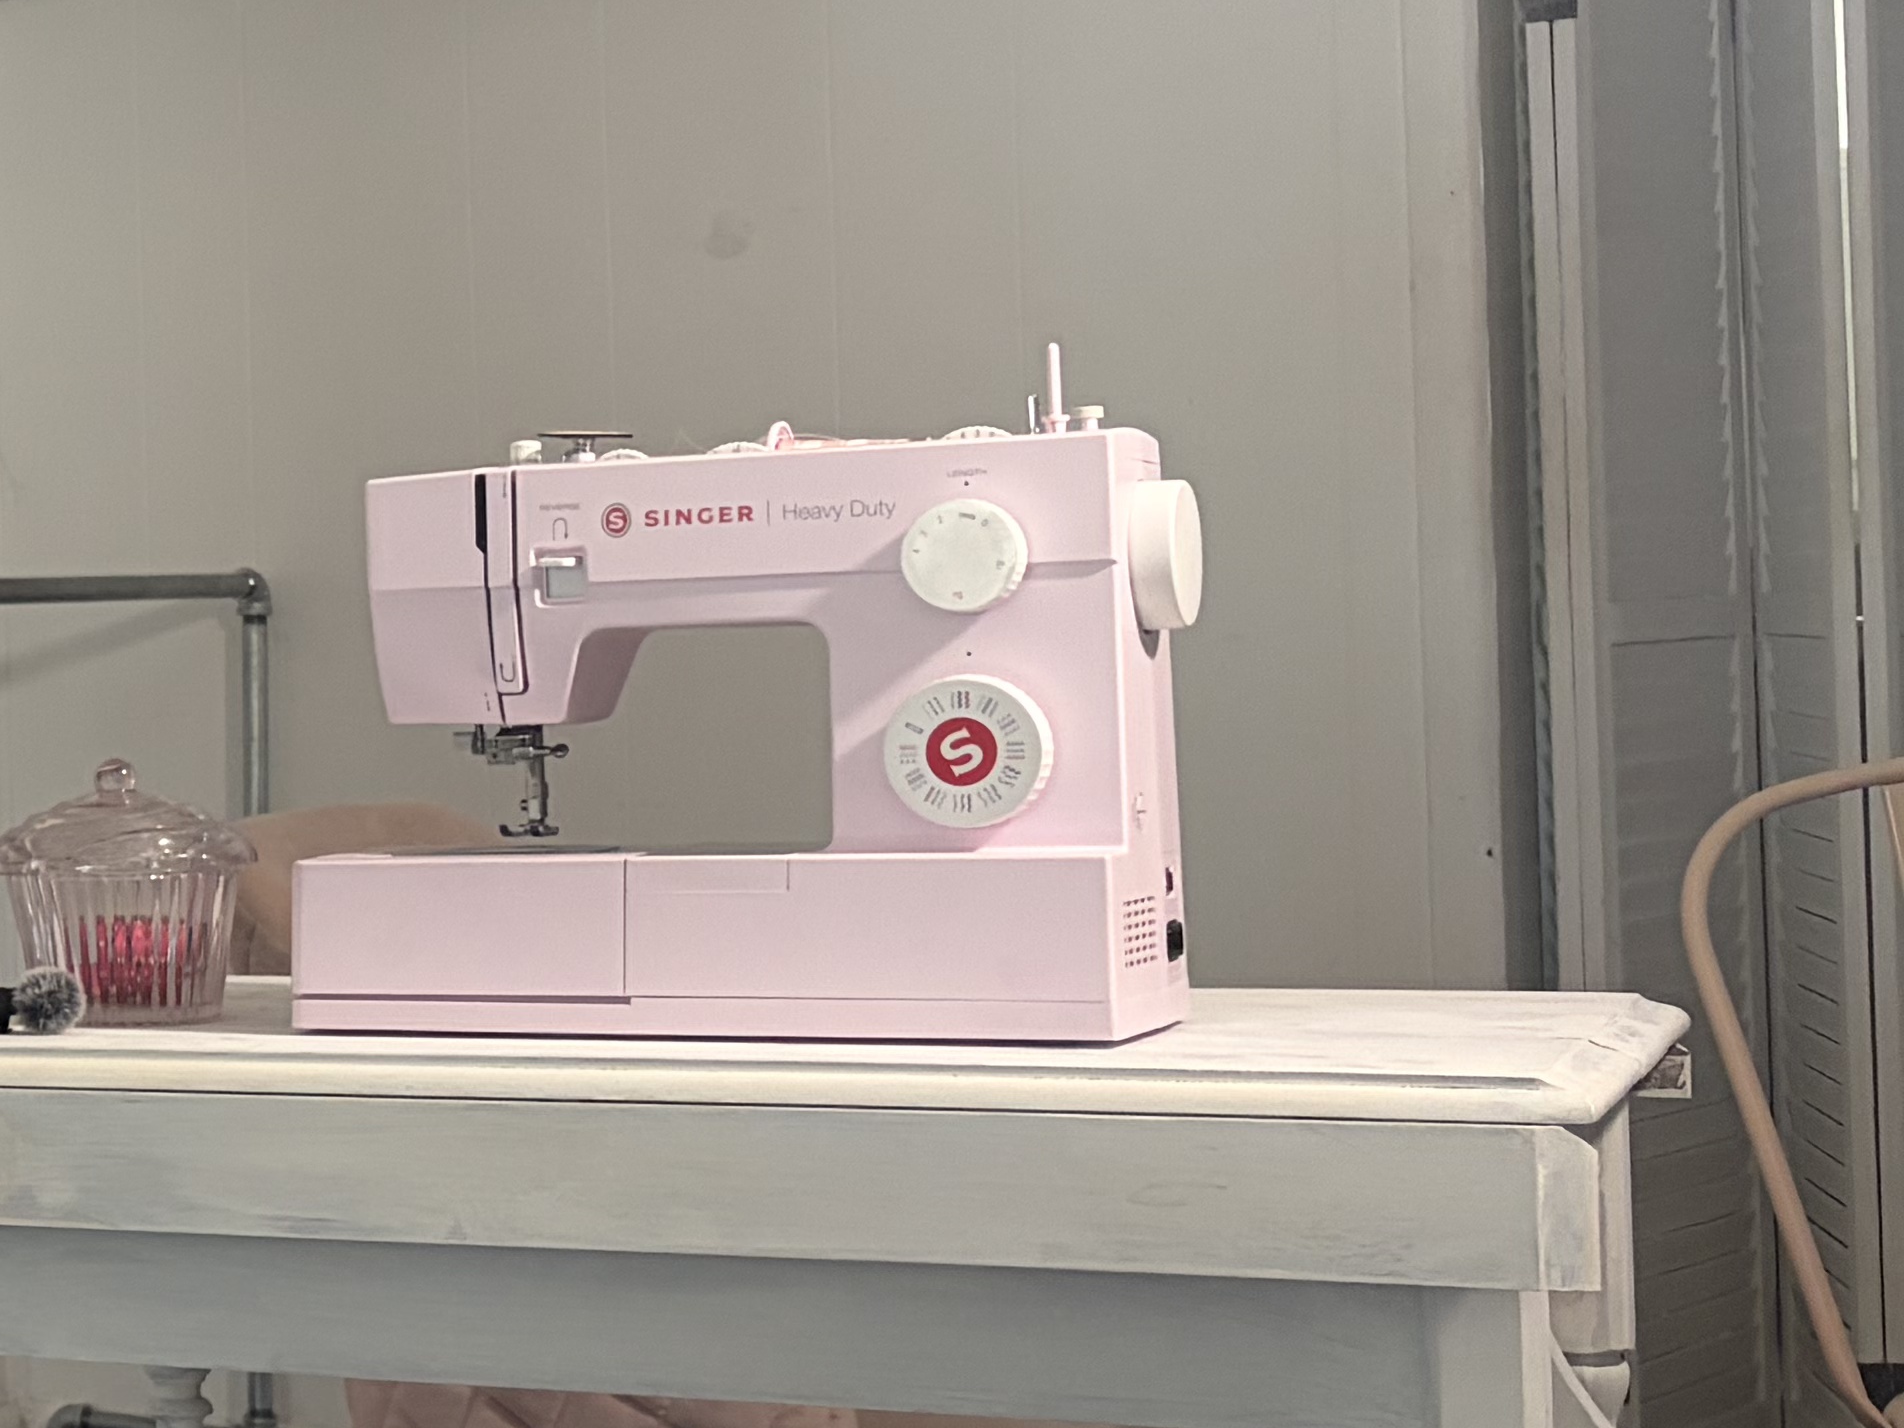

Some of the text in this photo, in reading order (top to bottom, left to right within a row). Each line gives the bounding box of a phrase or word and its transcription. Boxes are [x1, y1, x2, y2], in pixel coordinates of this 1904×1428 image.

[644, 505, 754, 527] SINGER
[782, 502, 844, 523] Heavy
[849, 499, 896, 520] Duty
[939, 726, 984, 778] S
